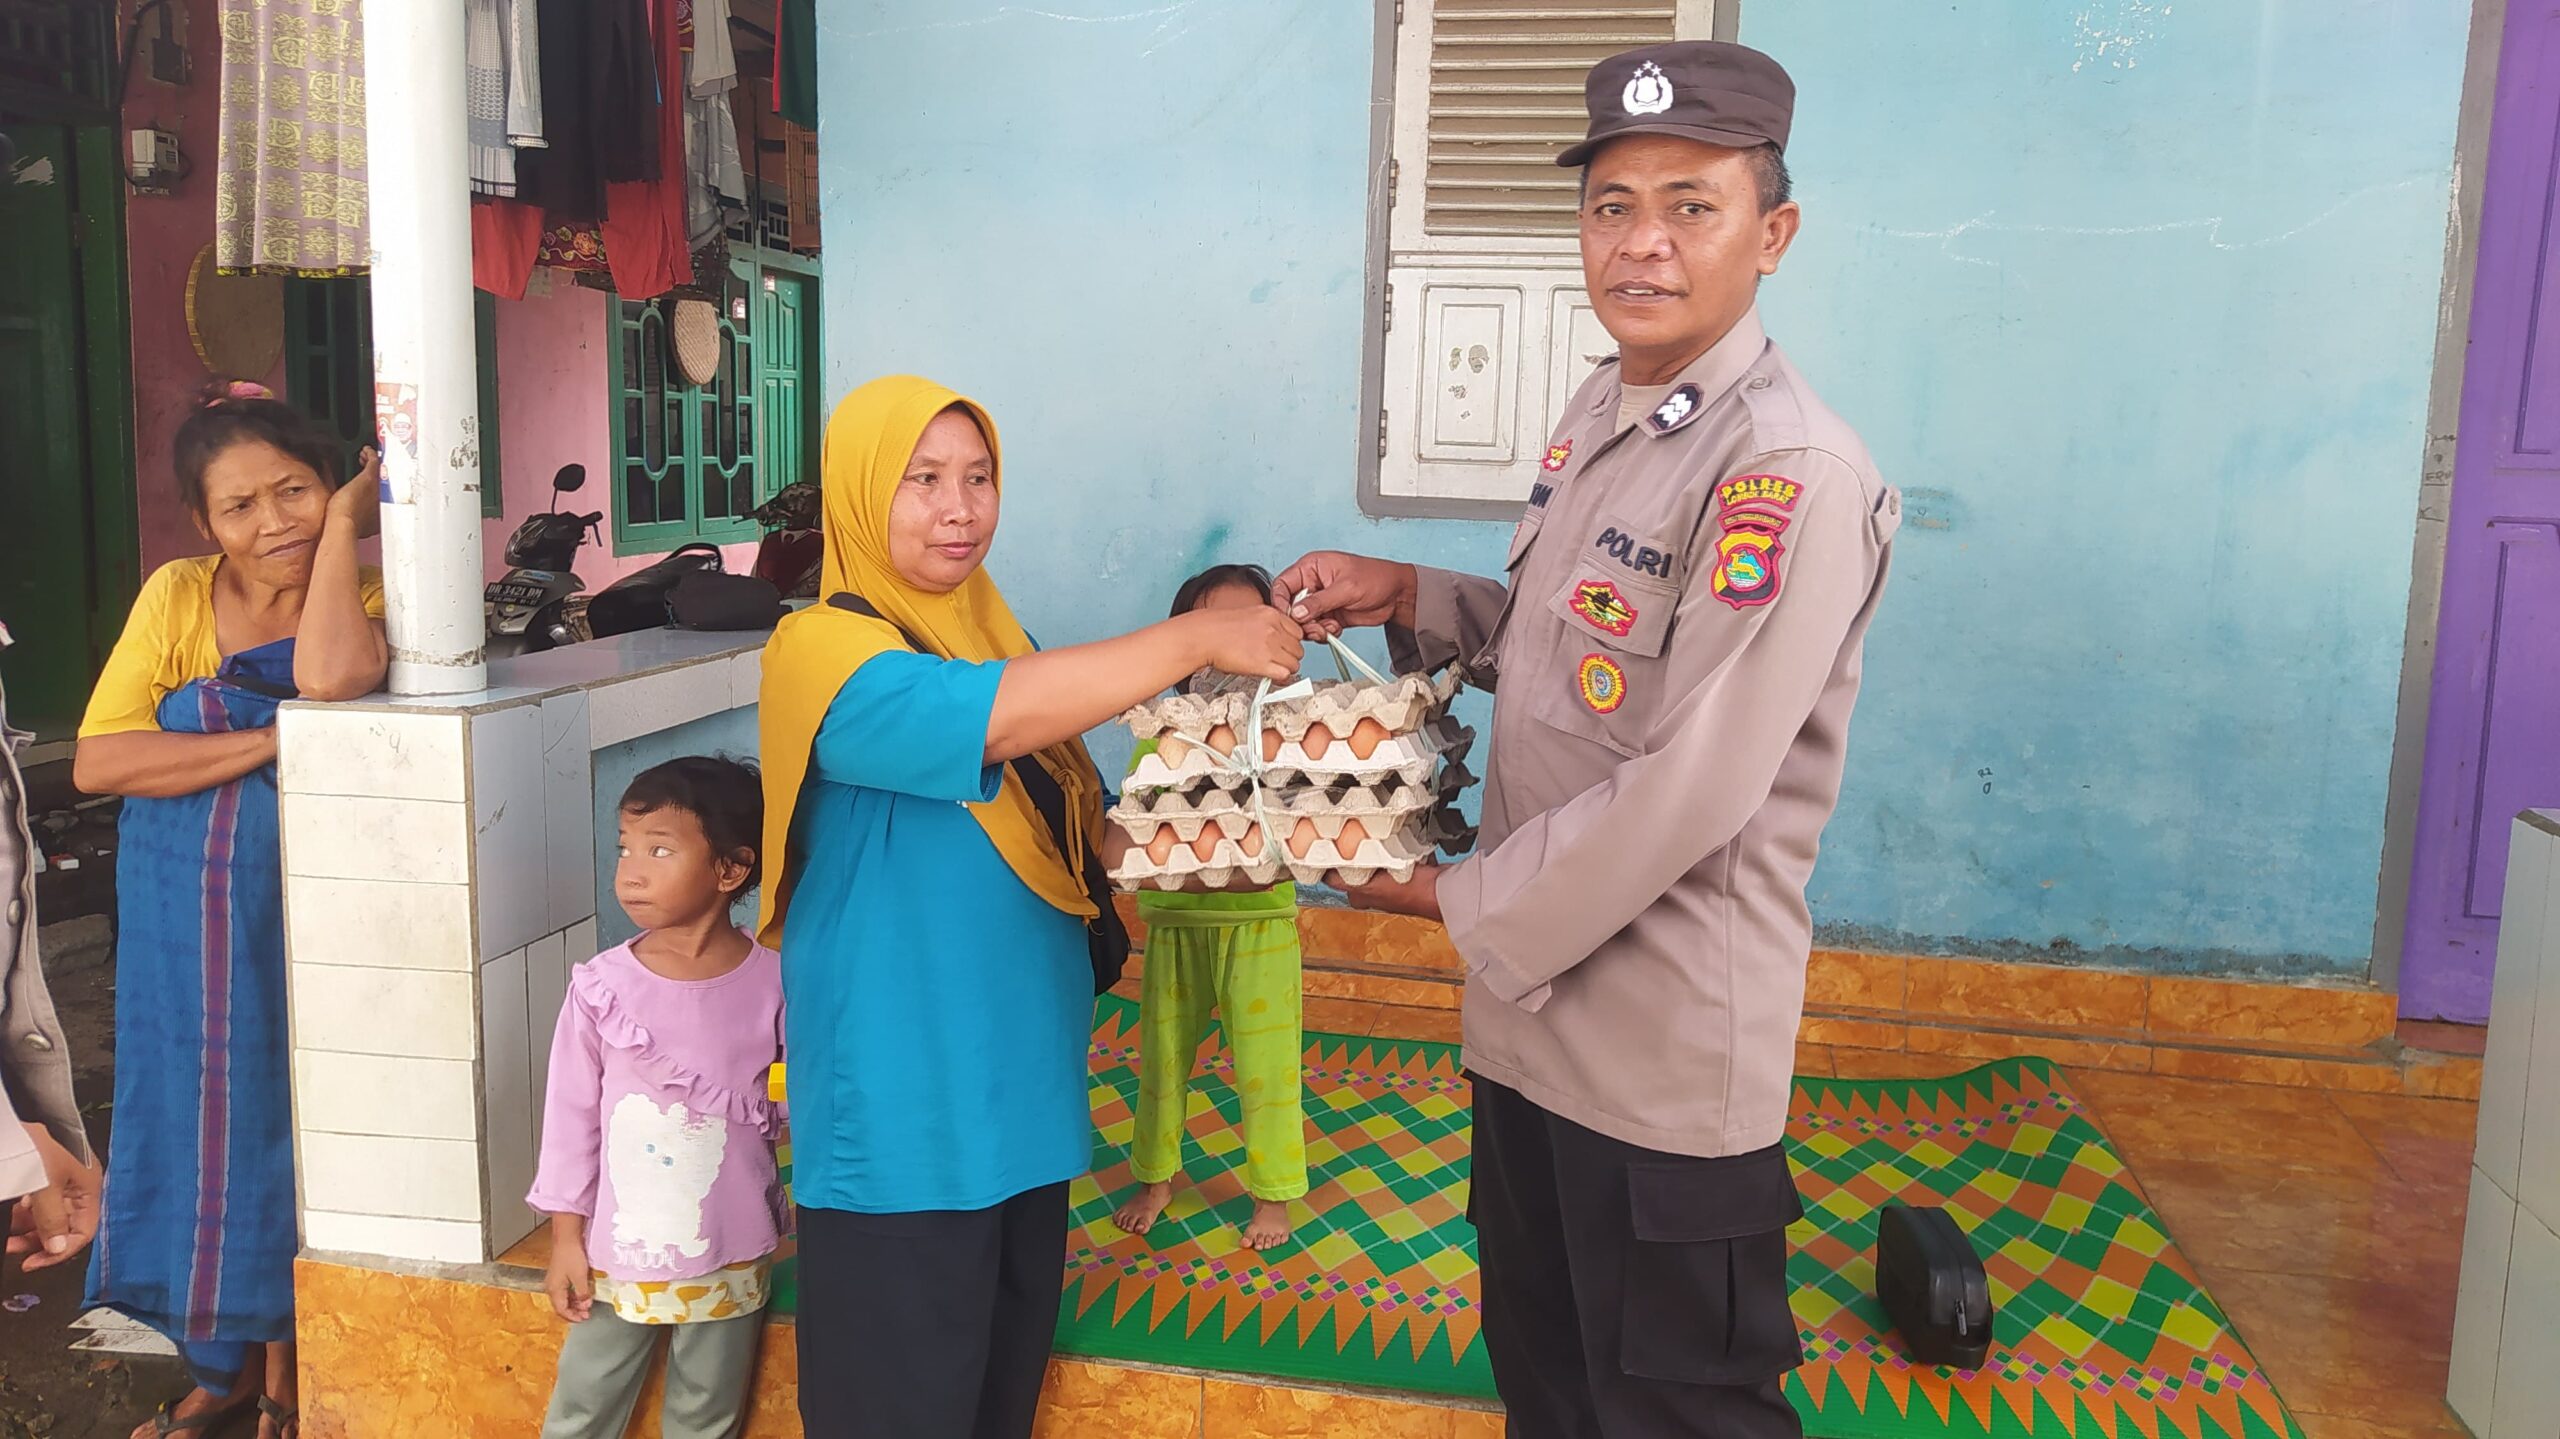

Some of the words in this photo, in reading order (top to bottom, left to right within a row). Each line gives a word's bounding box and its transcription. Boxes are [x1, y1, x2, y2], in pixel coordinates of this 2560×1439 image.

[1721, 477, 1797, 499] POLRES
[1595, 526, 1673, 579] POLRI
[487, 583, 504, 594] DR
[503, 584, 527, 597] 3421
